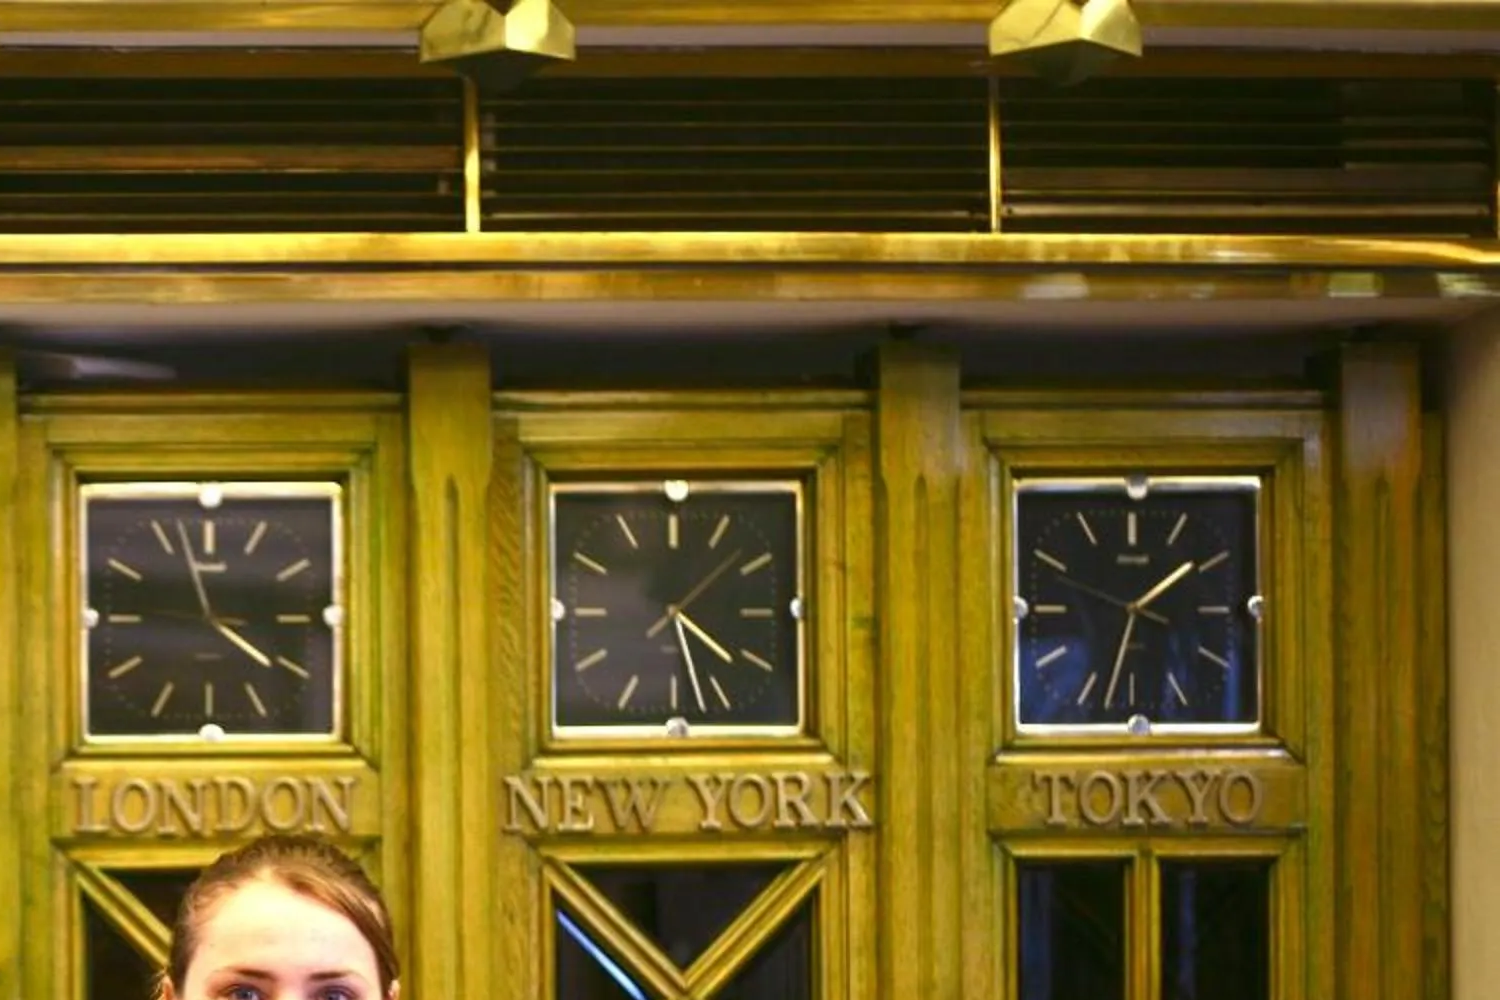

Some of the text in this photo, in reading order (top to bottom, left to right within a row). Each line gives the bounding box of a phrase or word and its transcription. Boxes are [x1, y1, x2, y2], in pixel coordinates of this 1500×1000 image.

[71, 775, 358, 837] LONDON
[502, 770, 874, 833] NEW YORK
[1032, 769, 1263, 827] TOKYO
